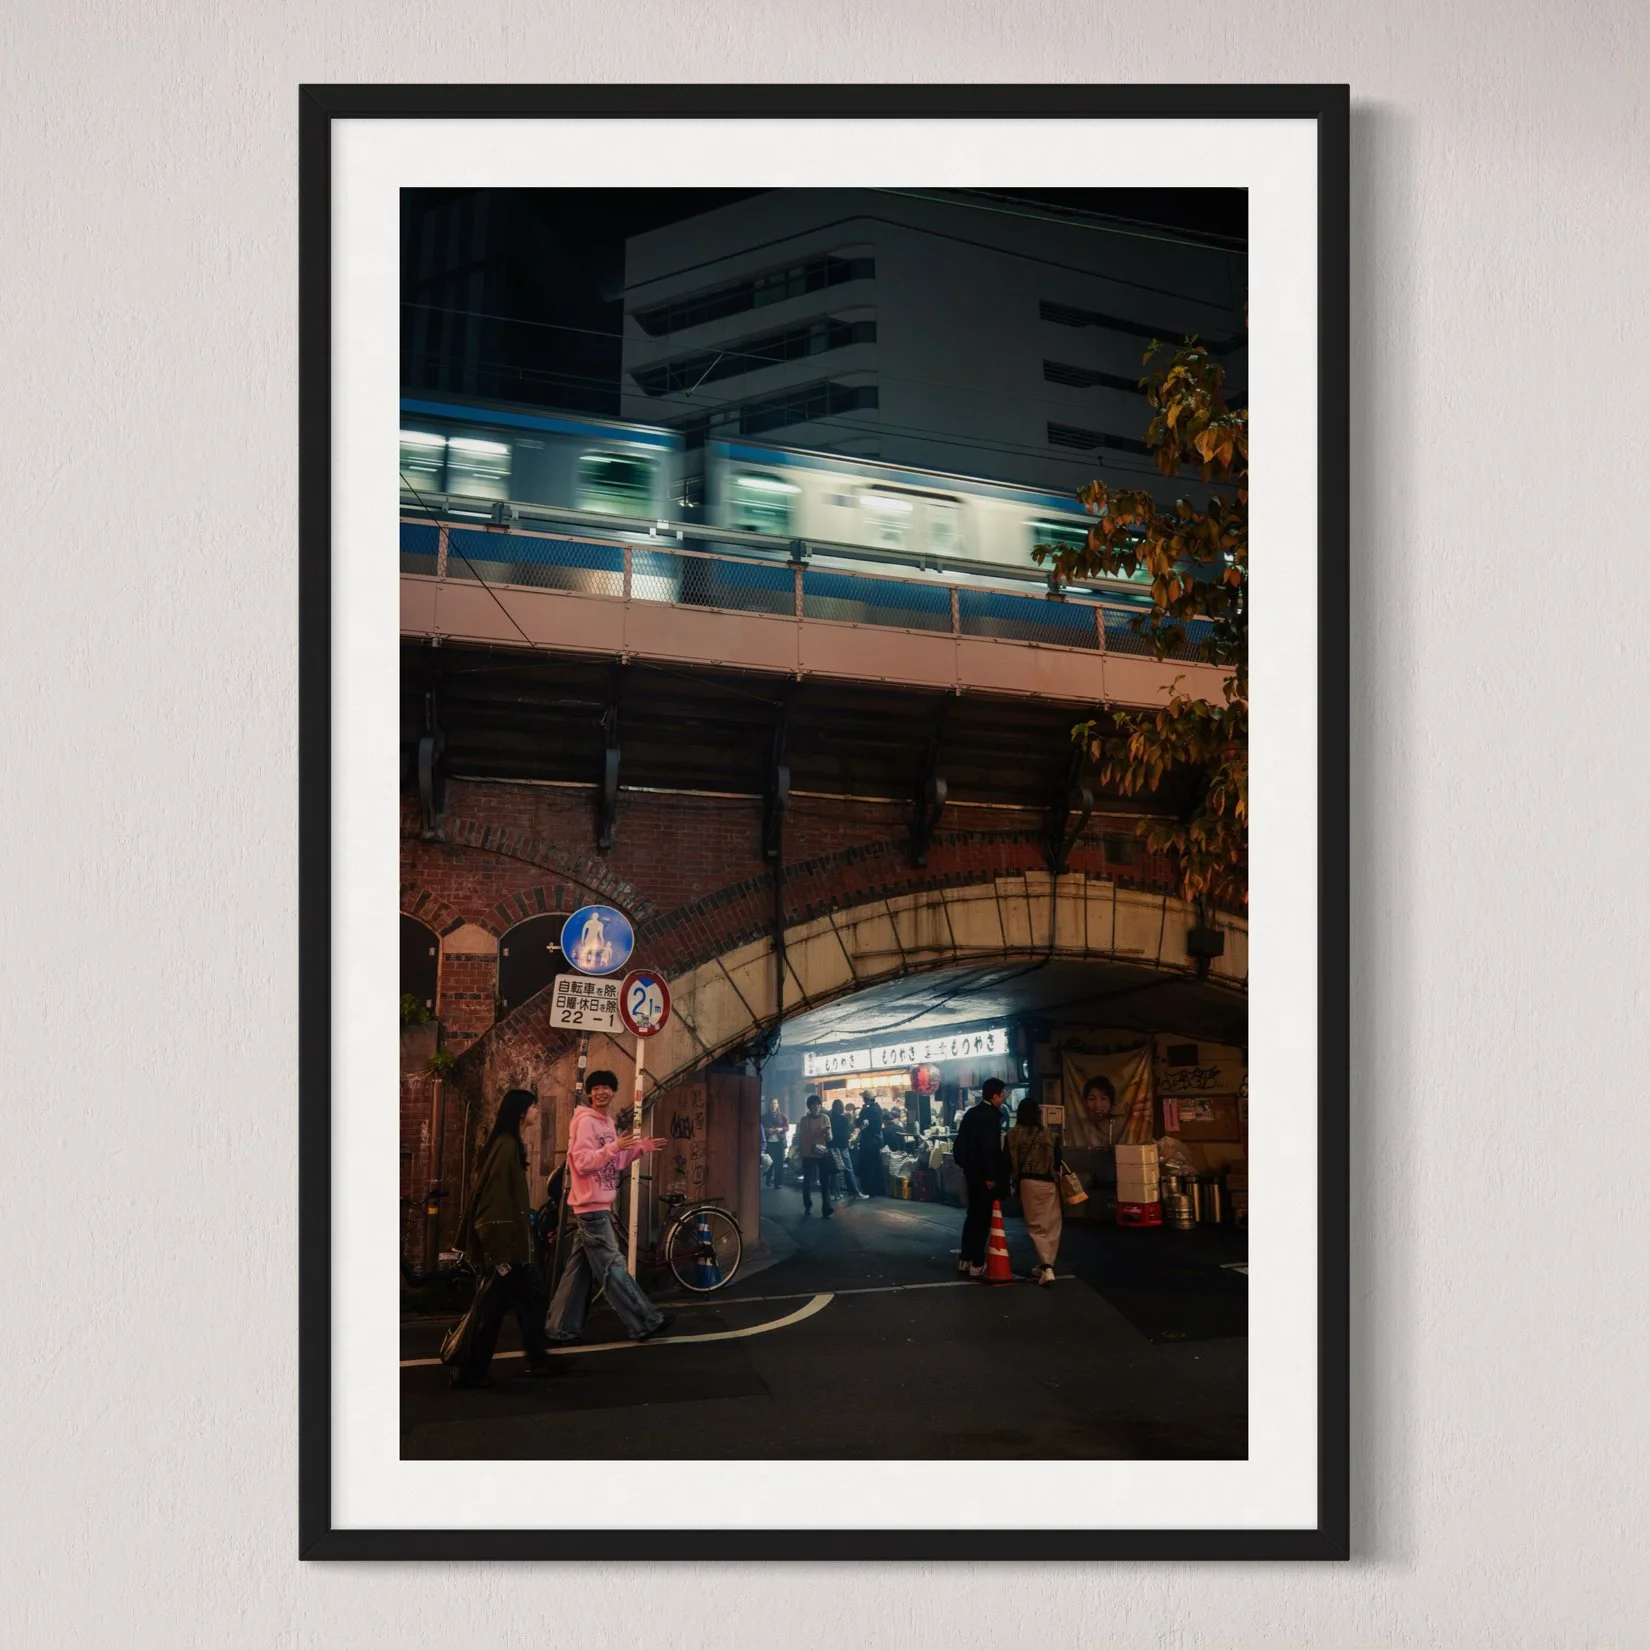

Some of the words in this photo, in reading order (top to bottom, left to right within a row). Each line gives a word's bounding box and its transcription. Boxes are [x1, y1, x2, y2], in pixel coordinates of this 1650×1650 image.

[558, 980, 619, 997] 自転車を除
[556, 996, 619, 1013] 日曜・休日を除
